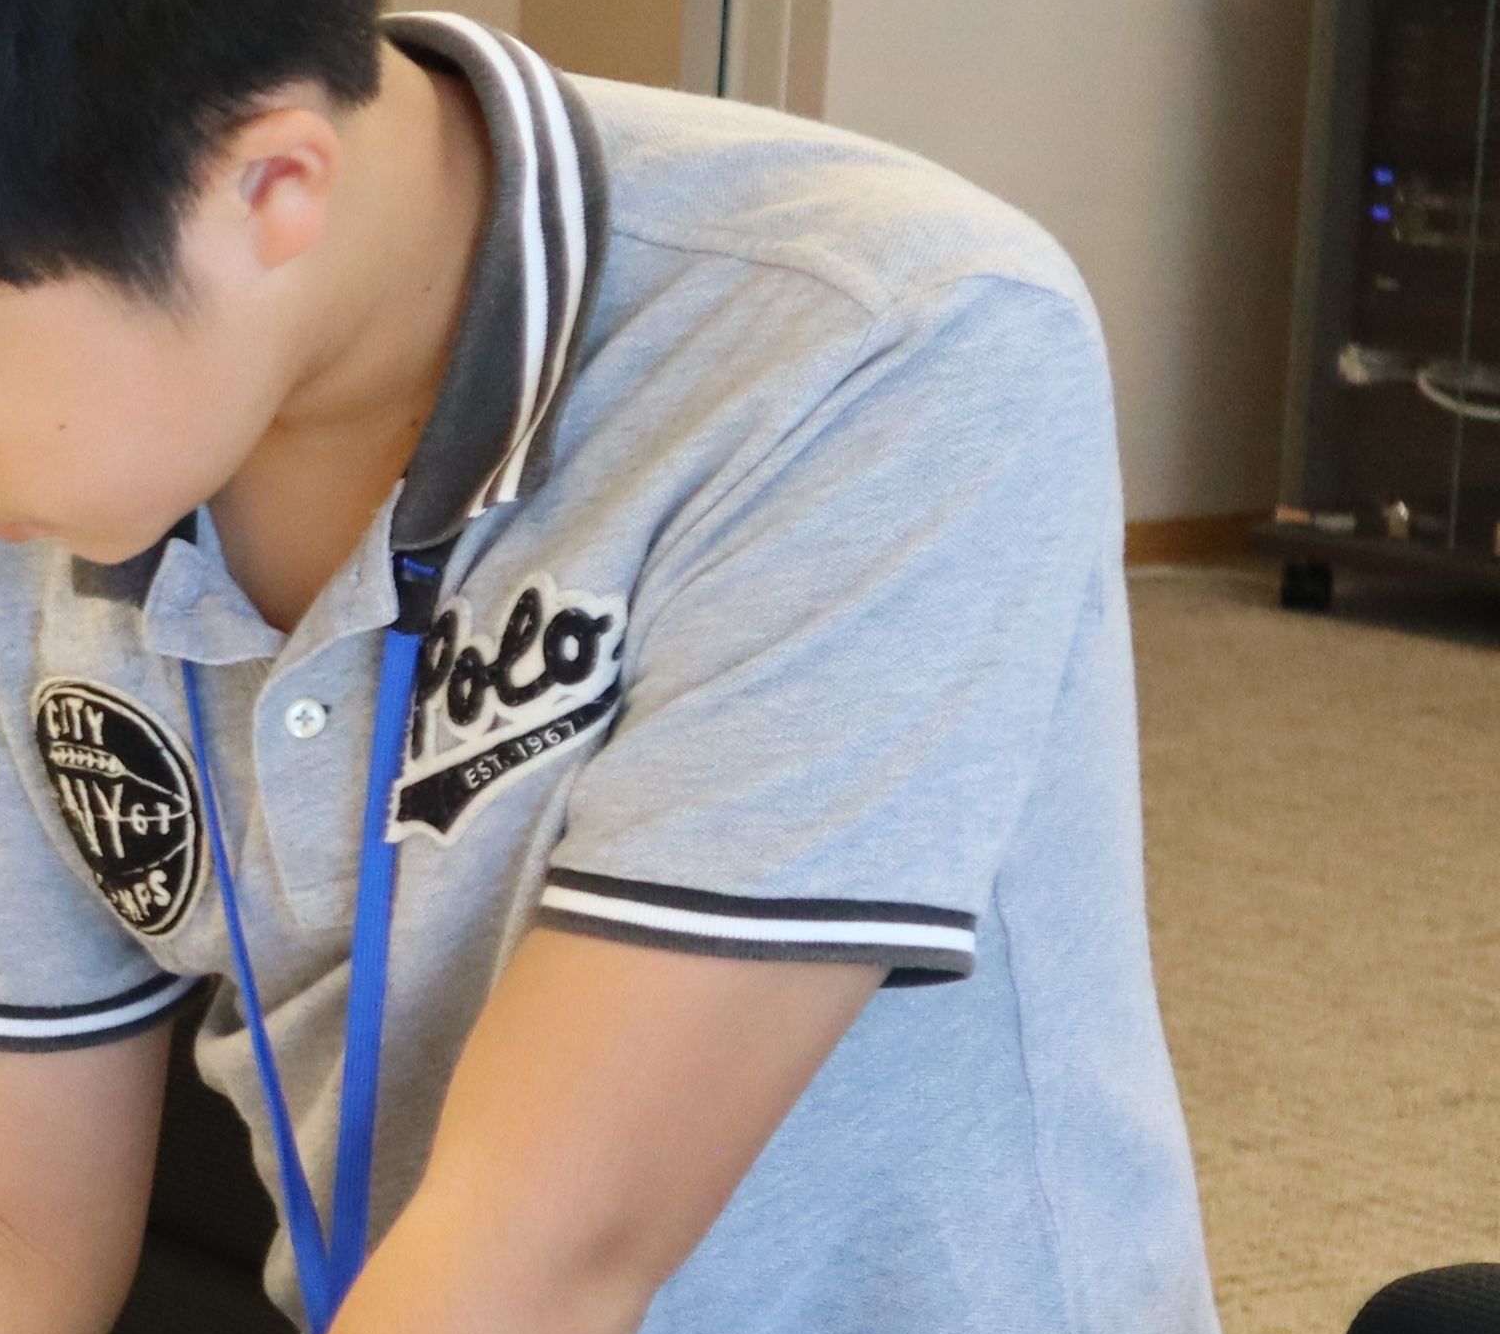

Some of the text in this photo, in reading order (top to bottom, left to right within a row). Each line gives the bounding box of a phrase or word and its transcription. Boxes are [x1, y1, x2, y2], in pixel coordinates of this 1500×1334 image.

[411, 586, 614, 761] Polo
[44, 697, 104, 746] CITY
[463, 721, 577, 789] EST. 1967
